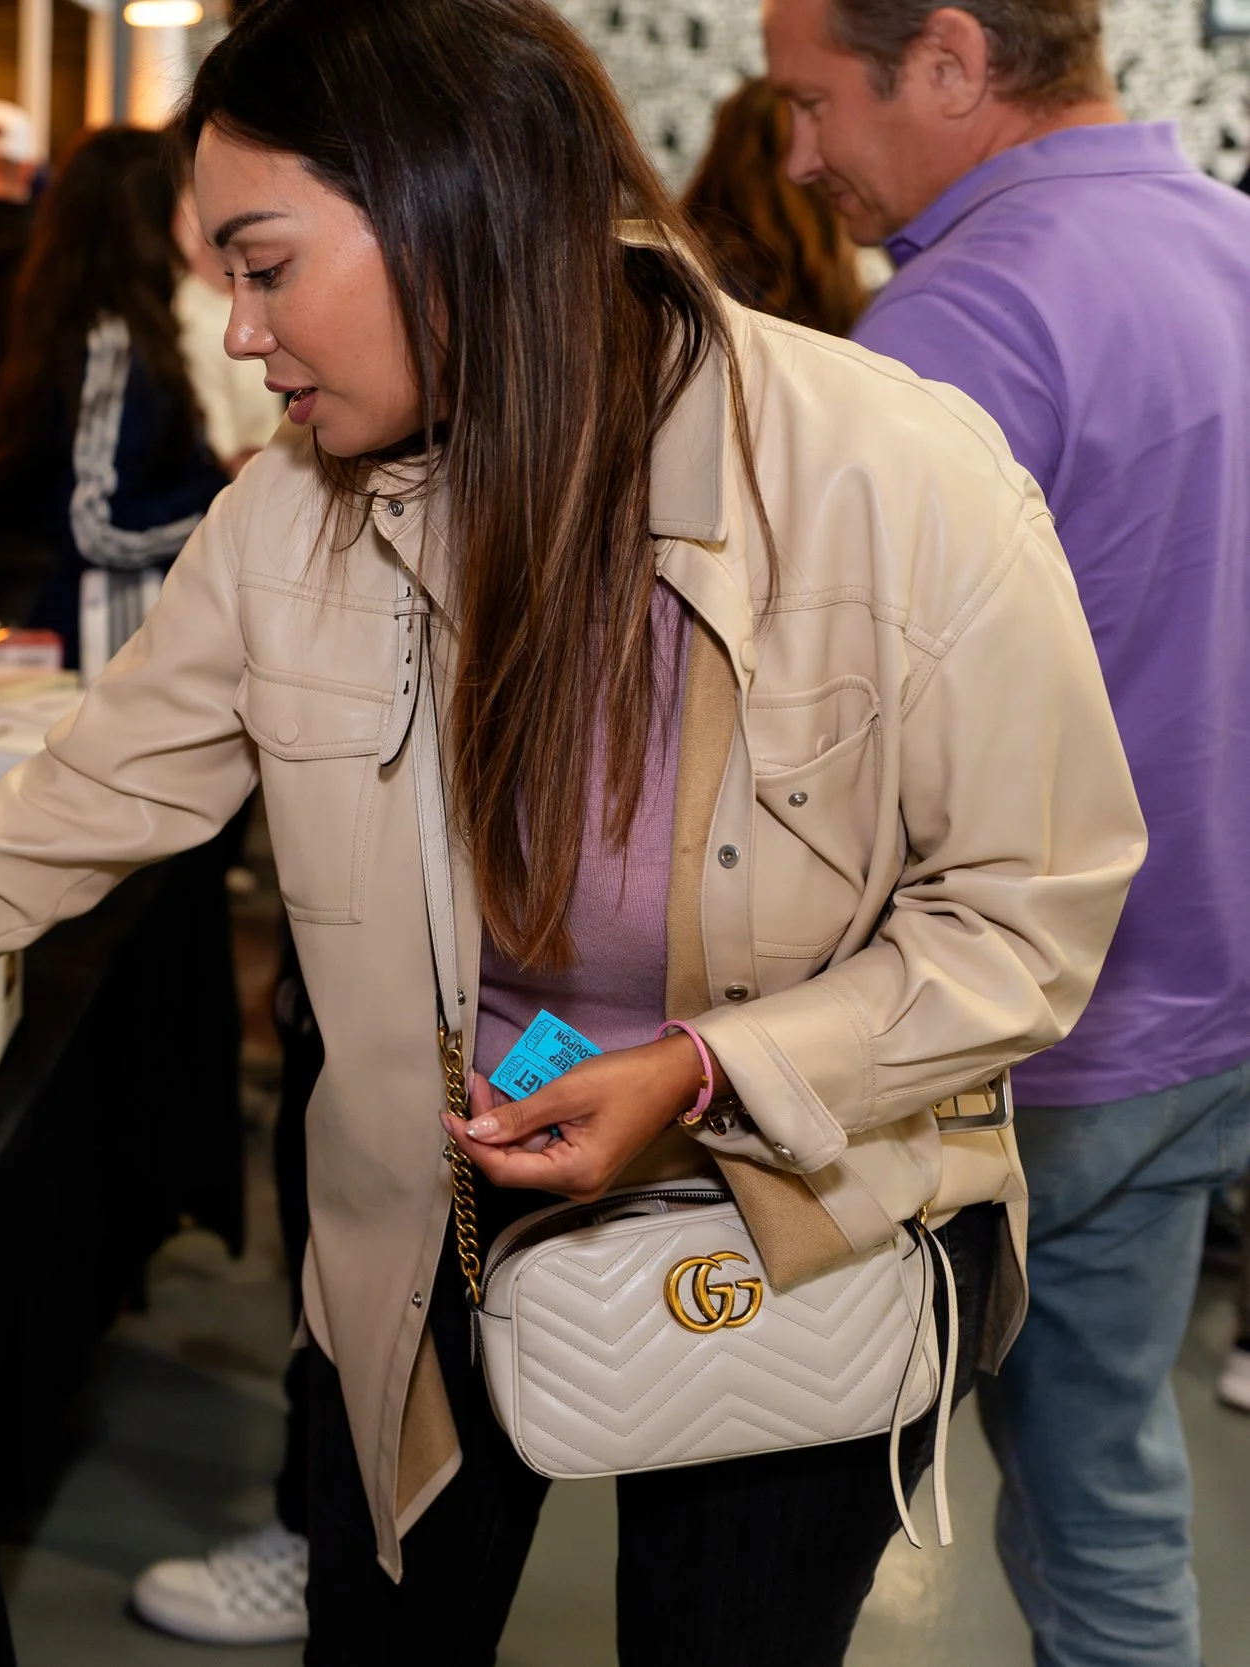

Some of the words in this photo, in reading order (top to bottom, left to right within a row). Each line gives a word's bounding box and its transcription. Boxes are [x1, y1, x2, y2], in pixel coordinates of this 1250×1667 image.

[549, 1054, 573, 1071] EEP
[559, 1047, 577, 1064] THIS
[663, 1250, 763, 1335] GG
